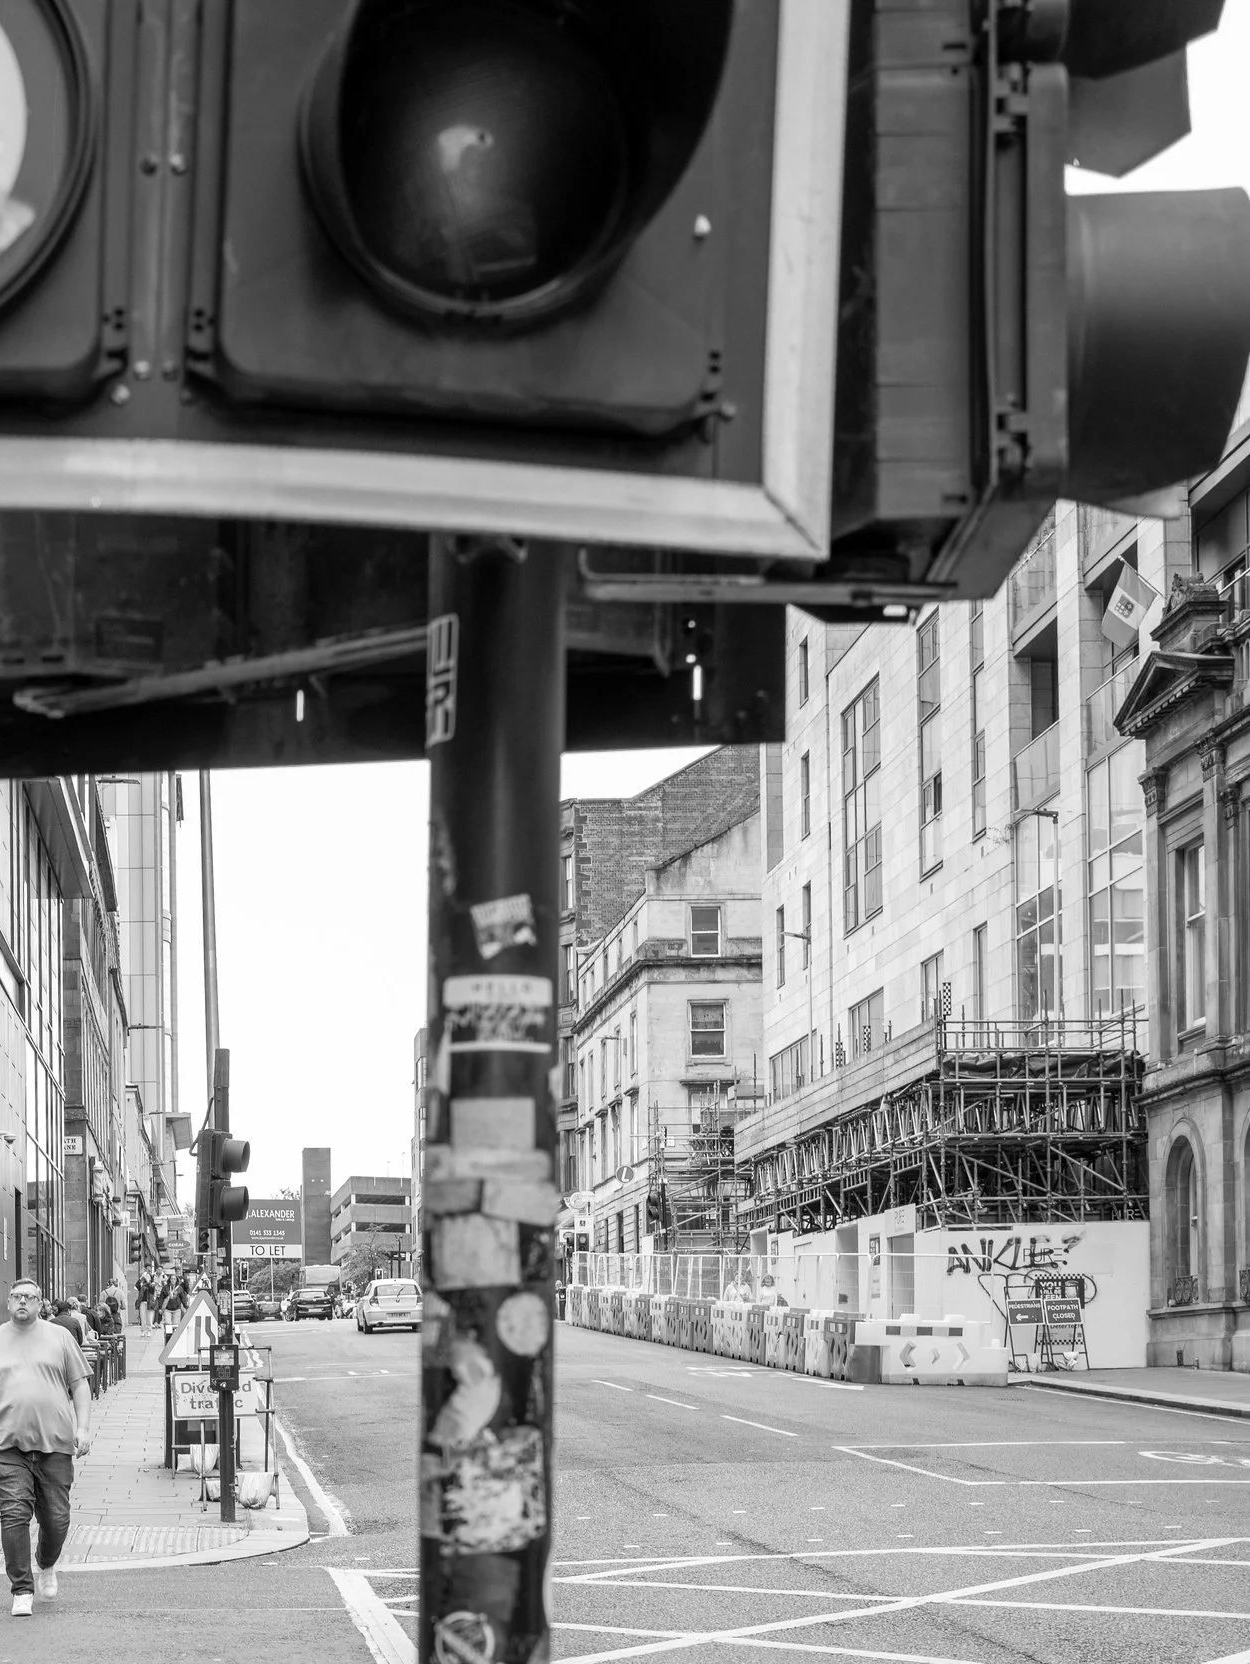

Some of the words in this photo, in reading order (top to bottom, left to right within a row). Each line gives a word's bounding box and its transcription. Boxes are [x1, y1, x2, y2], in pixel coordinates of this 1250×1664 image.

[245, 1209, 295, 1220] J.ALEXANDER
[249, 1245, 265, 1256] TO
[269, 1245, 286, 1256] LET
